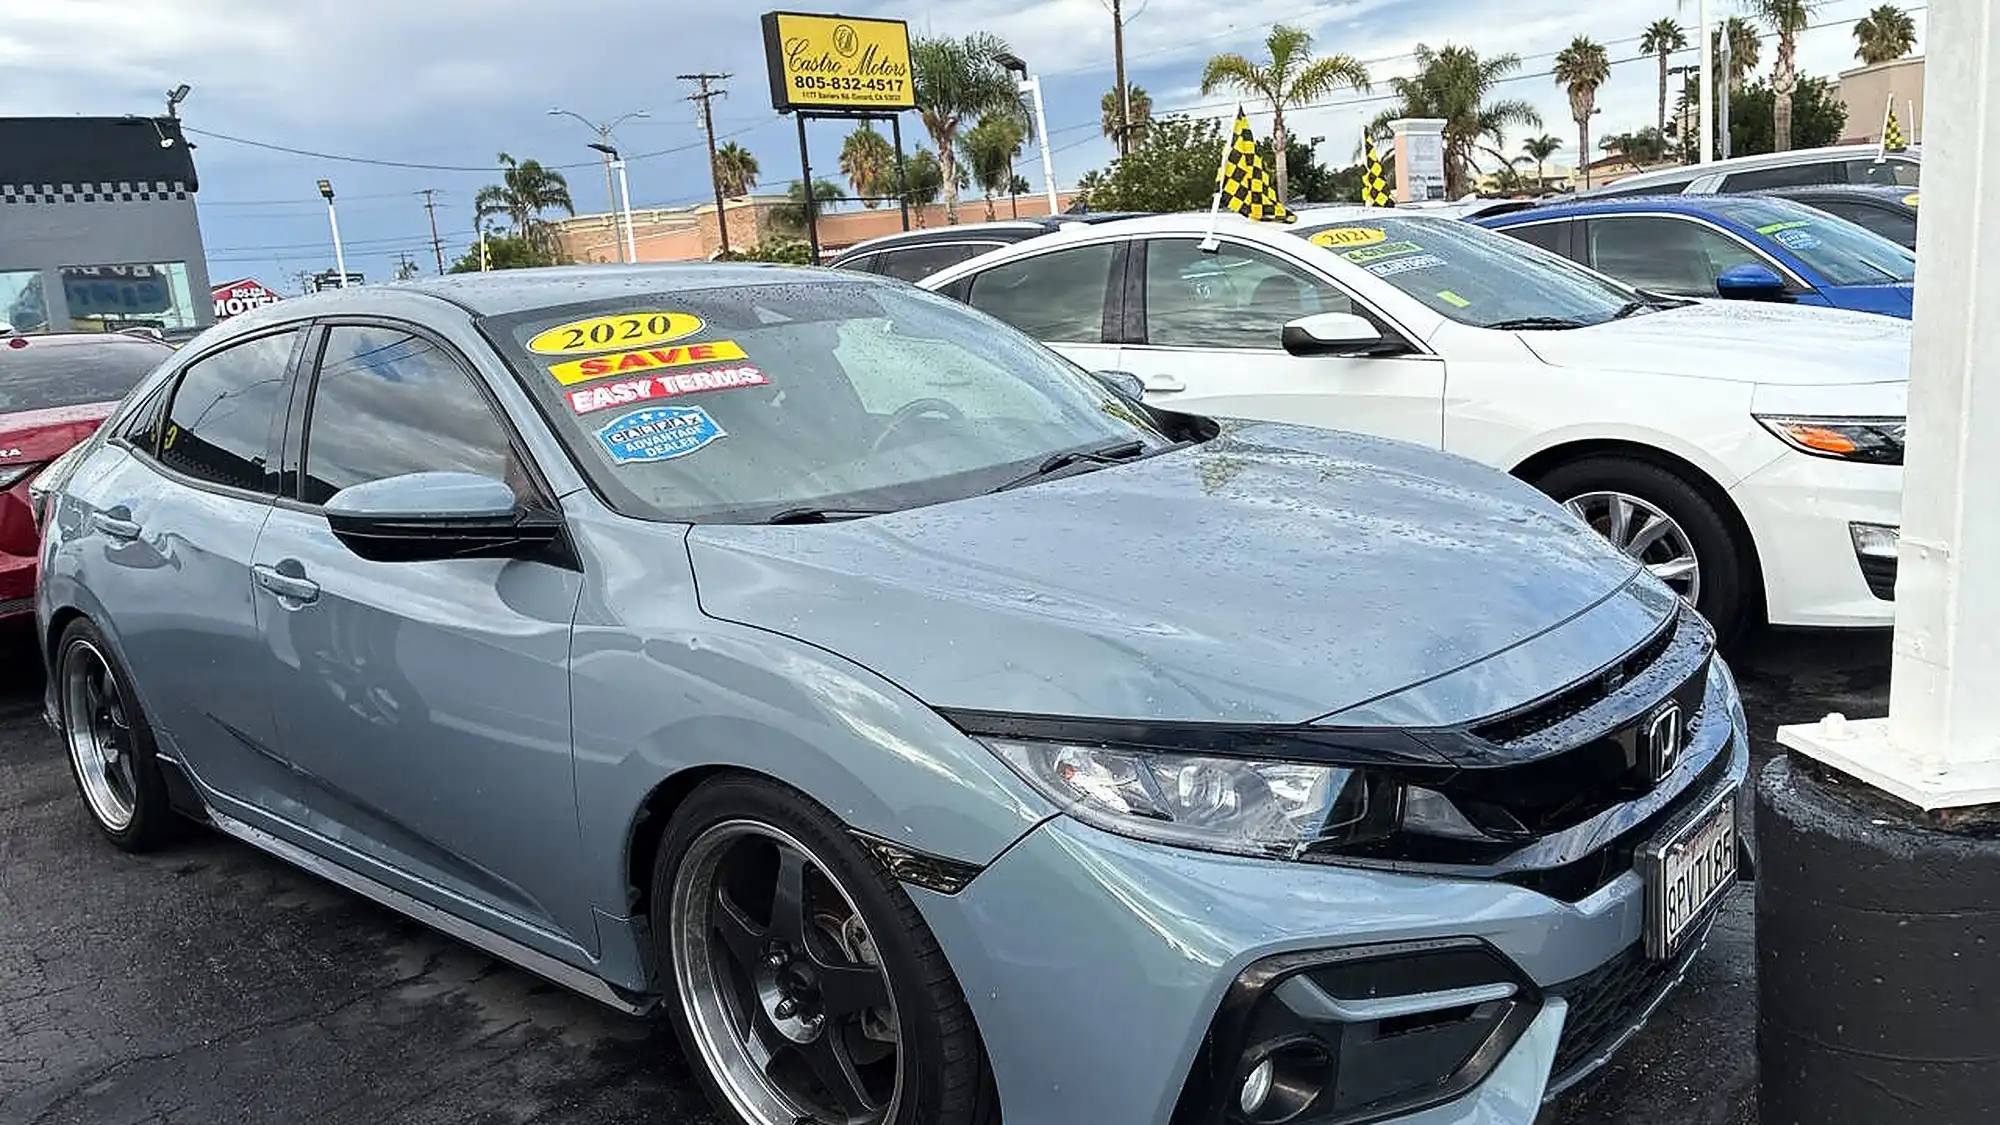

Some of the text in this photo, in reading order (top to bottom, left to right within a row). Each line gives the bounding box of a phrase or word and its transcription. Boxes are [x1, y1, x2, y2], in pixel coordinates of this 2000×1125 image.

[785, 37, 841, 73] Castro
[848, 44, 907, 77] Motors
[795, 76, 903, 92] 805-832-4517
[1323, 229, 1372, 245] 2021
[562, 316, 672, 351] 2020
[579, 345, 718, 377] SAVE
[571, 366, 764, 413] EASY TERMS
[609, 412, 705, 444] CARFAX
[626, 426, 704, 452] ADVANTAGE
[648, 437, 701, 457] DEALER
[1666, 827, 1732, 935] 8PVT185
